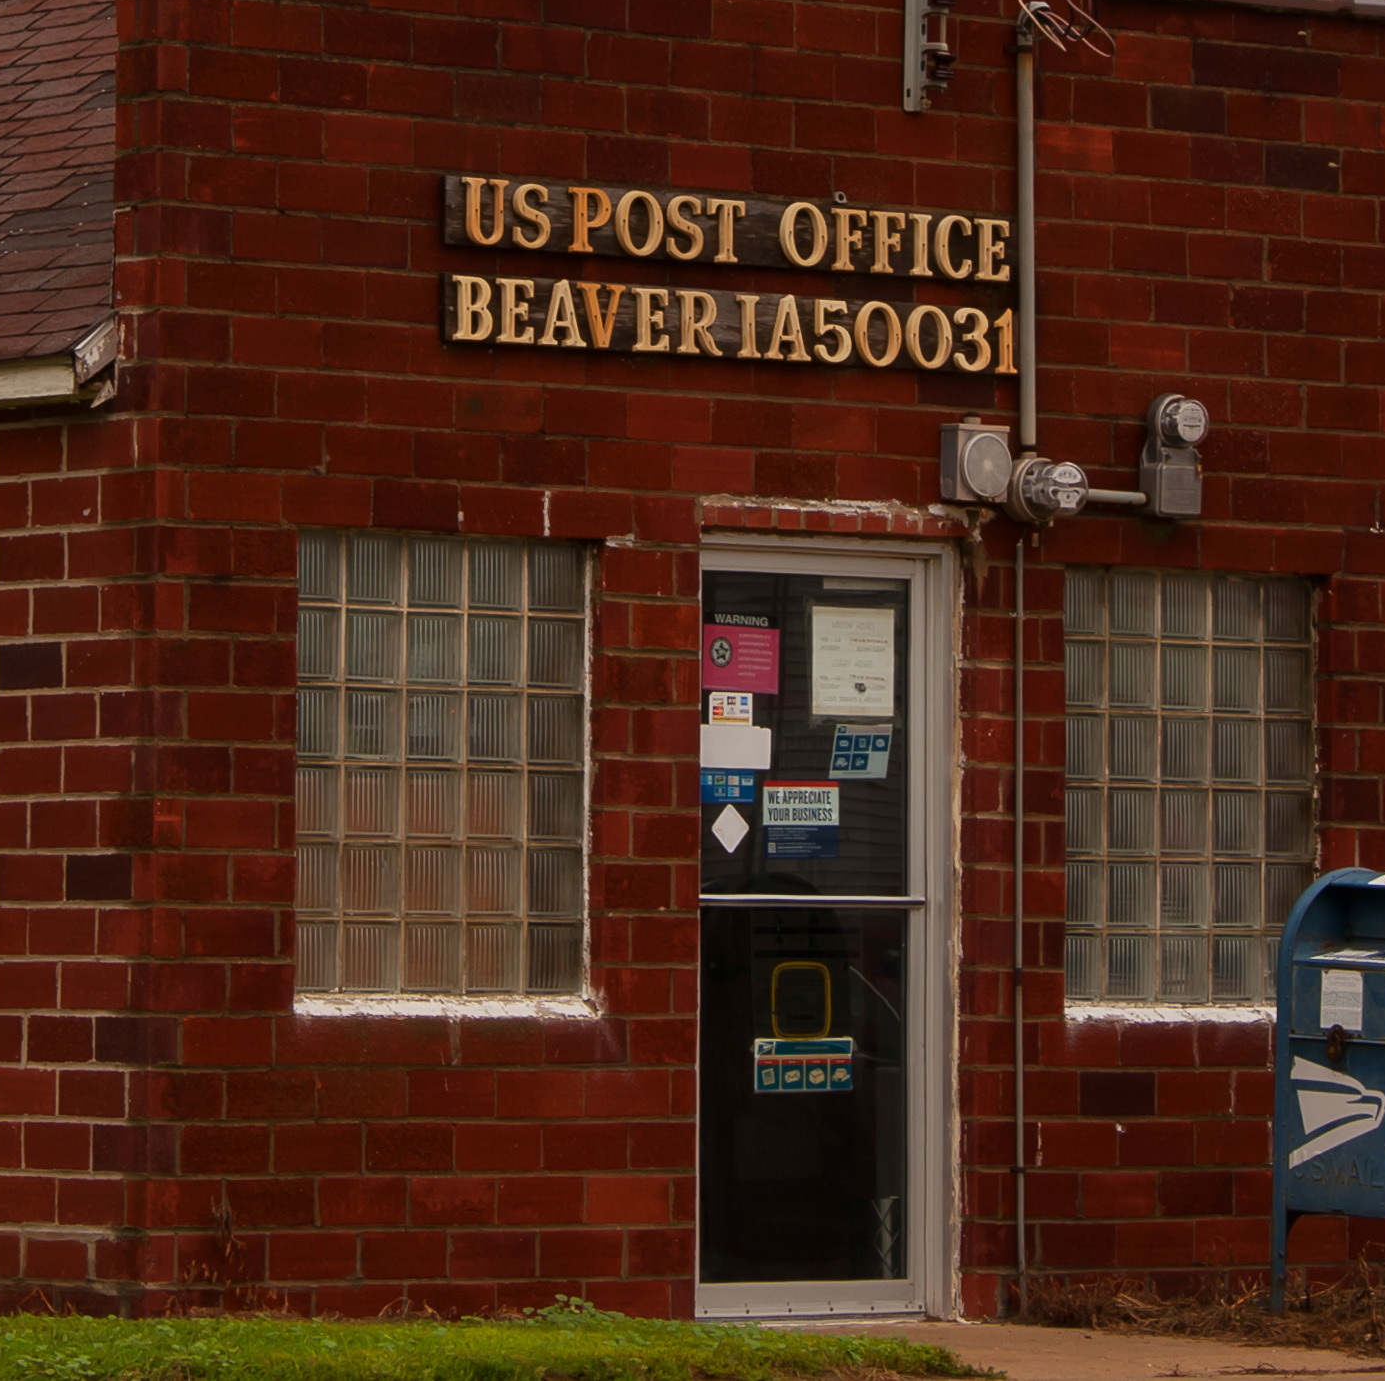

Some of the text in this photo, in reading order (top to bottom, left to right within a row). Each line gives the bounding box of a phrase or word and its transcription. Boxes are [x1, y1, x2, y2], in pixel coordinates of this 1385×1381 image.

[461, 176, 1010, 282] US POST OFFICE
[452, 274, 723, 357] BEAVER
[714, 612, 769, 627] WARNING
[767, 790, 832, 805] WE APPRECIATE
[768, 807, 833, 822] YOUR BUSINESS
